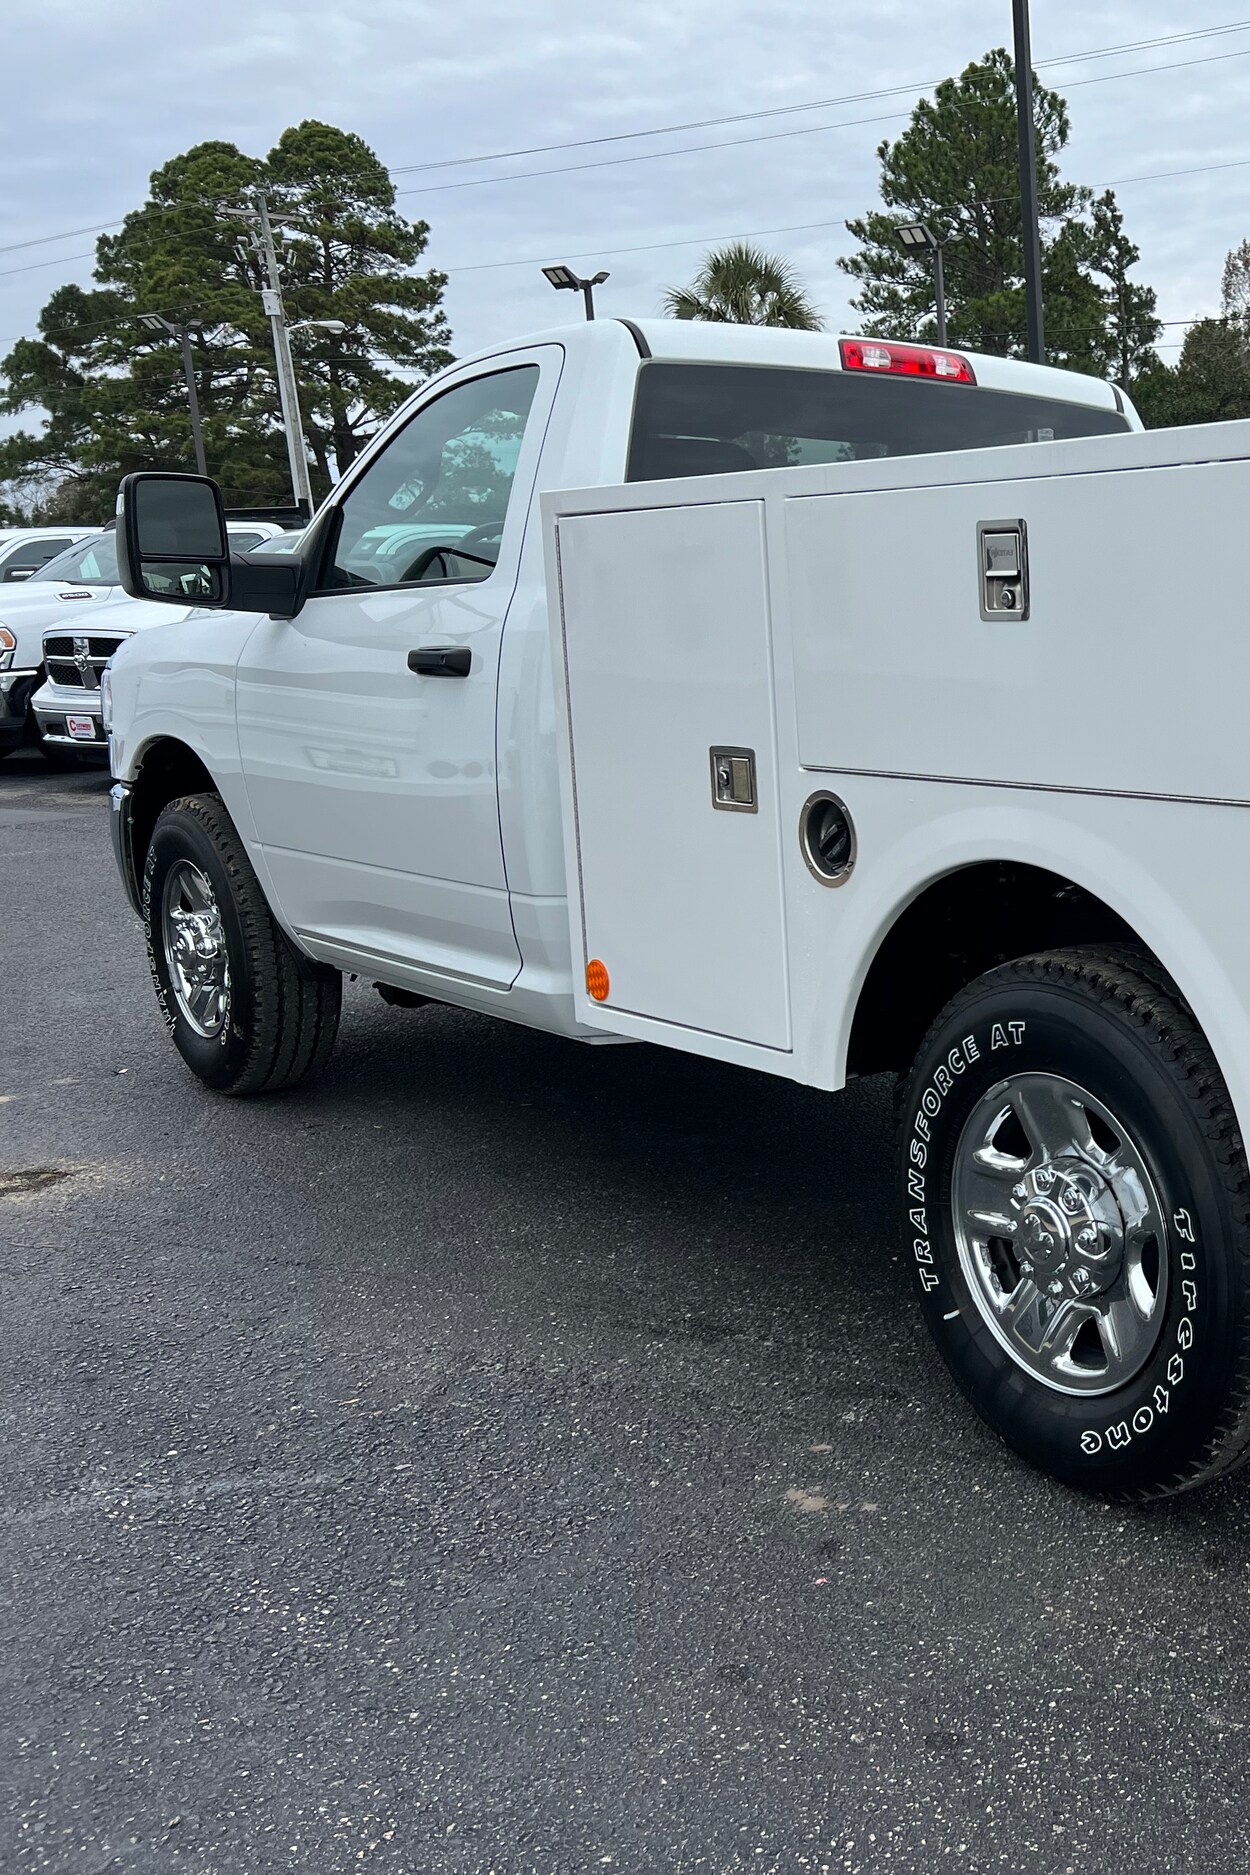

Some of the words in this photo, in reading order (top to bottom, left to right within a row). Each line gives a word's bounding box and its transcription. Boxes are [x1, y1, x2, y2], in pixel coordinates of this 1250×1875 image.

[909, 1036, 980, 1292] TRANSFORCE
[991, 1021, 1027, 1050] AT
[1080, 1207, 1198, 1455] Firestone
